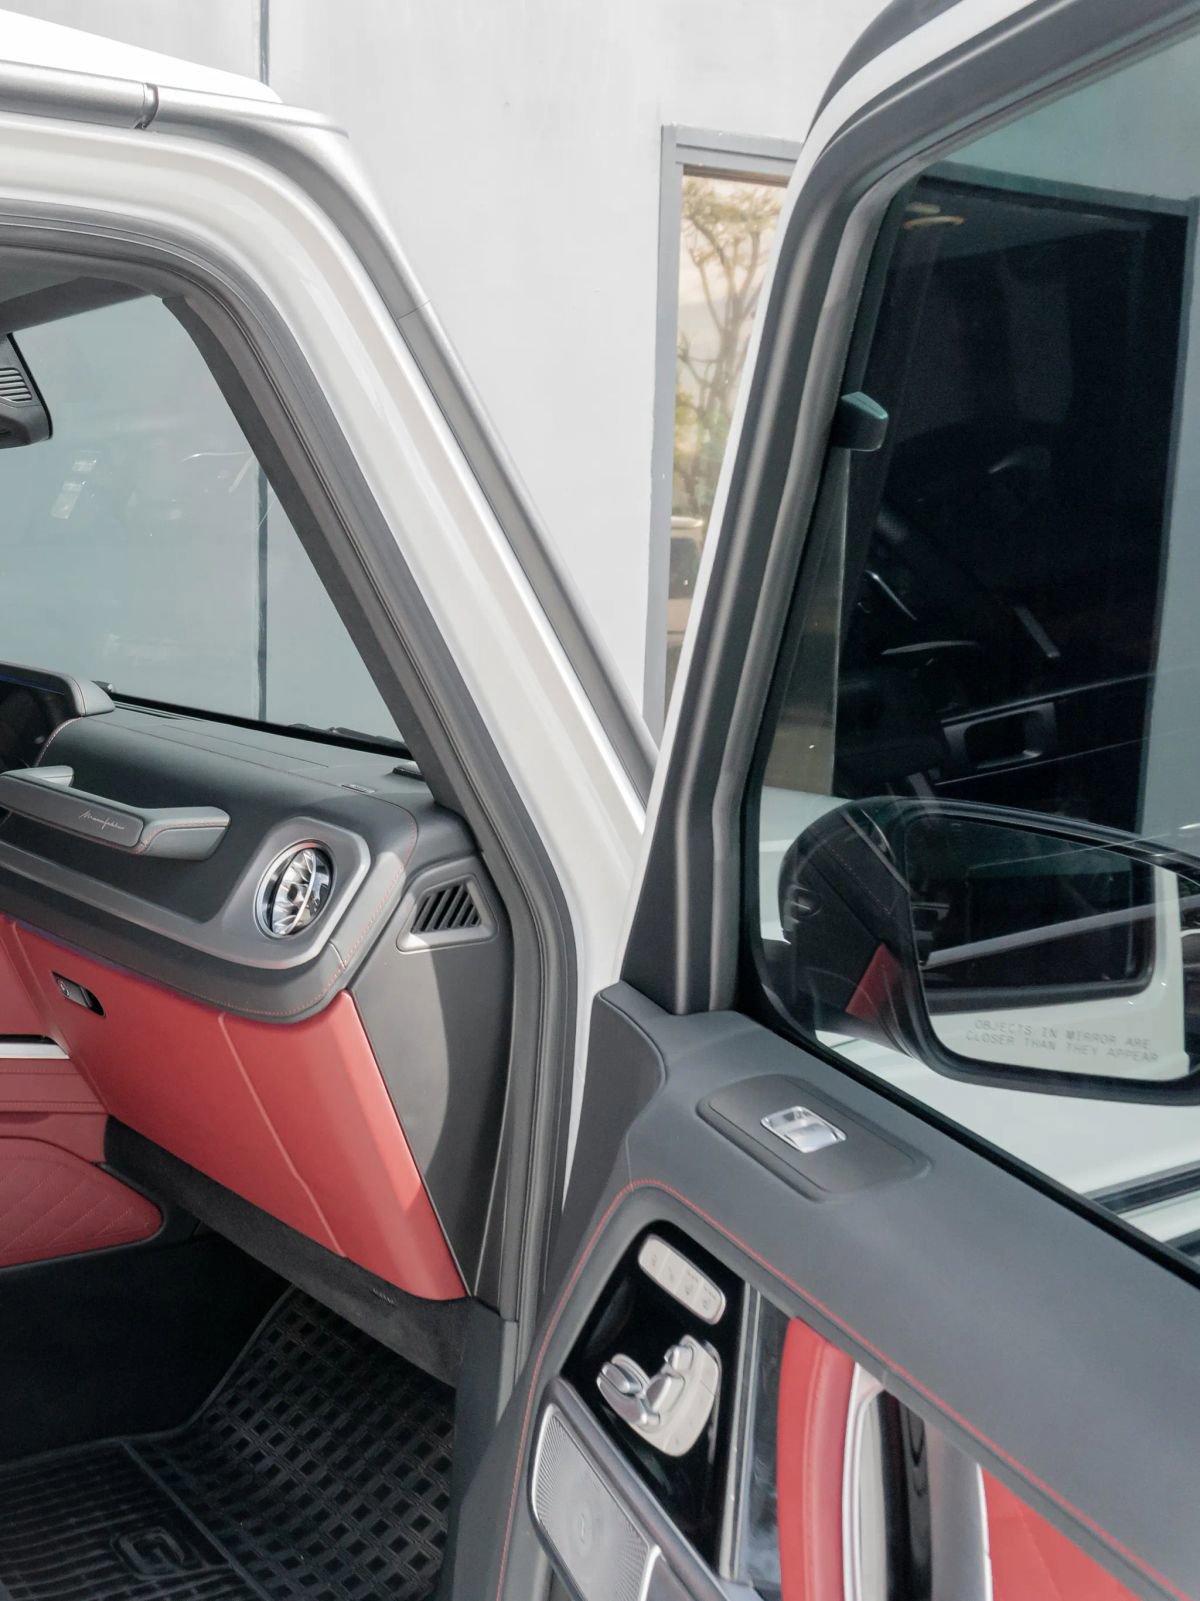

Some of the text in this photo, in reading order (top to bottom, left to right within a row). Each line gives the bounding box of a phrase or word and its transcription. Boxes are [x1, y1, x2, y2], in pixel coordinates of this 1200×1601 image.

[966, 1029, 1159, 1063] CLOSER THAN THEY APPEAR
[974, 1019, 1151, 1050] OBJECTS IN MIRROR ARE
